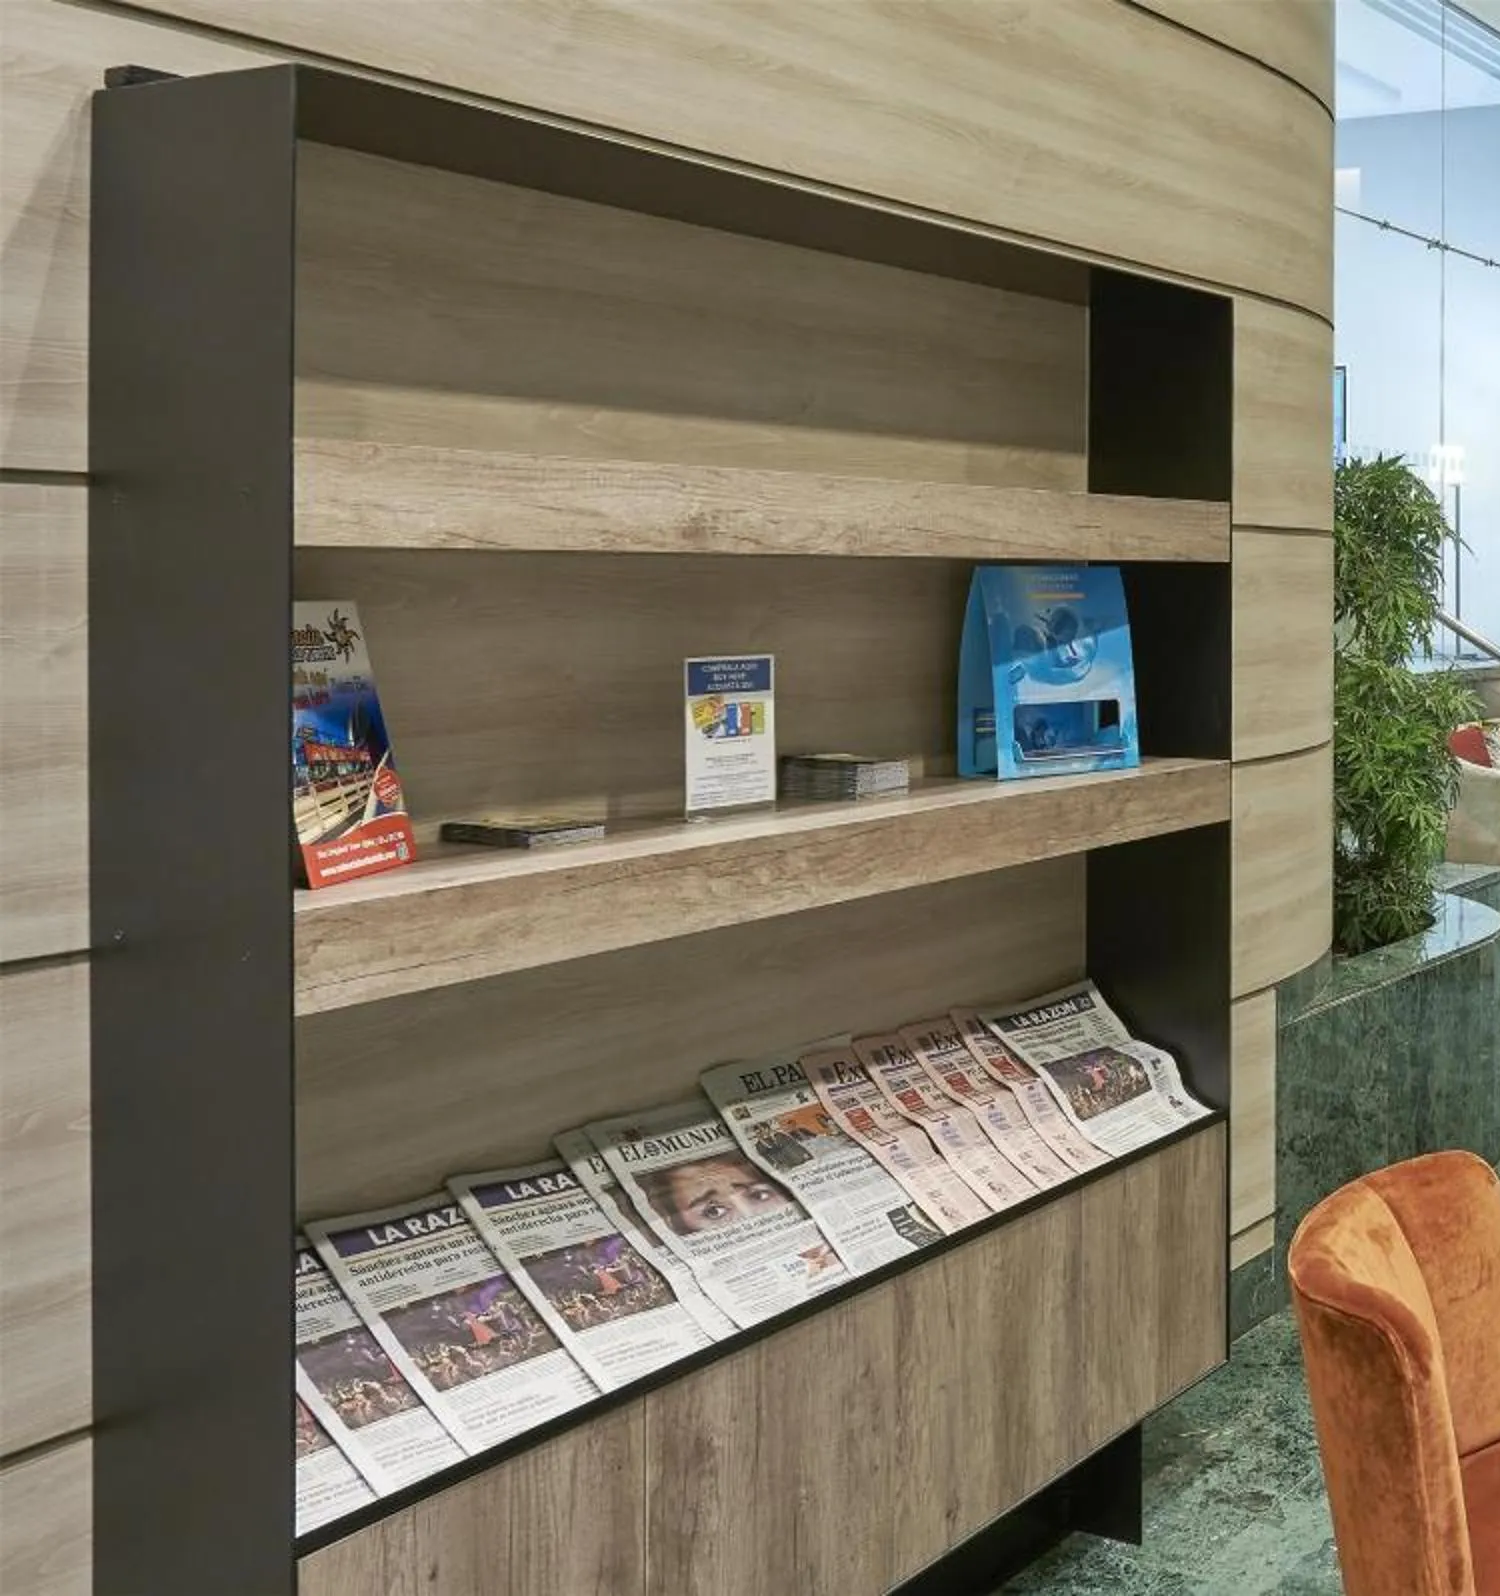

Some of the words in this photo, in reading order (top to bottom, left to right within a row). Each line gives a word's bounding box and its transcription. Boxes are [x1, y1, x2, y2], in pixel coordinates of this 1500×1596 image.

[739, 1071, 774, 1094] EL
[770, 1061, 806, 1085] PA
[618, 1144, 649, 1162] EL
[504, 1181, 540, 1200] LA
[538, 1172, 578, 1193] RA
[367, 1224, 407, 1246] LA
[404, 1207, 466, 1236] RAZ
[296, 1251, 322, 1274] A
[435, 1250, 461, 1267] para
